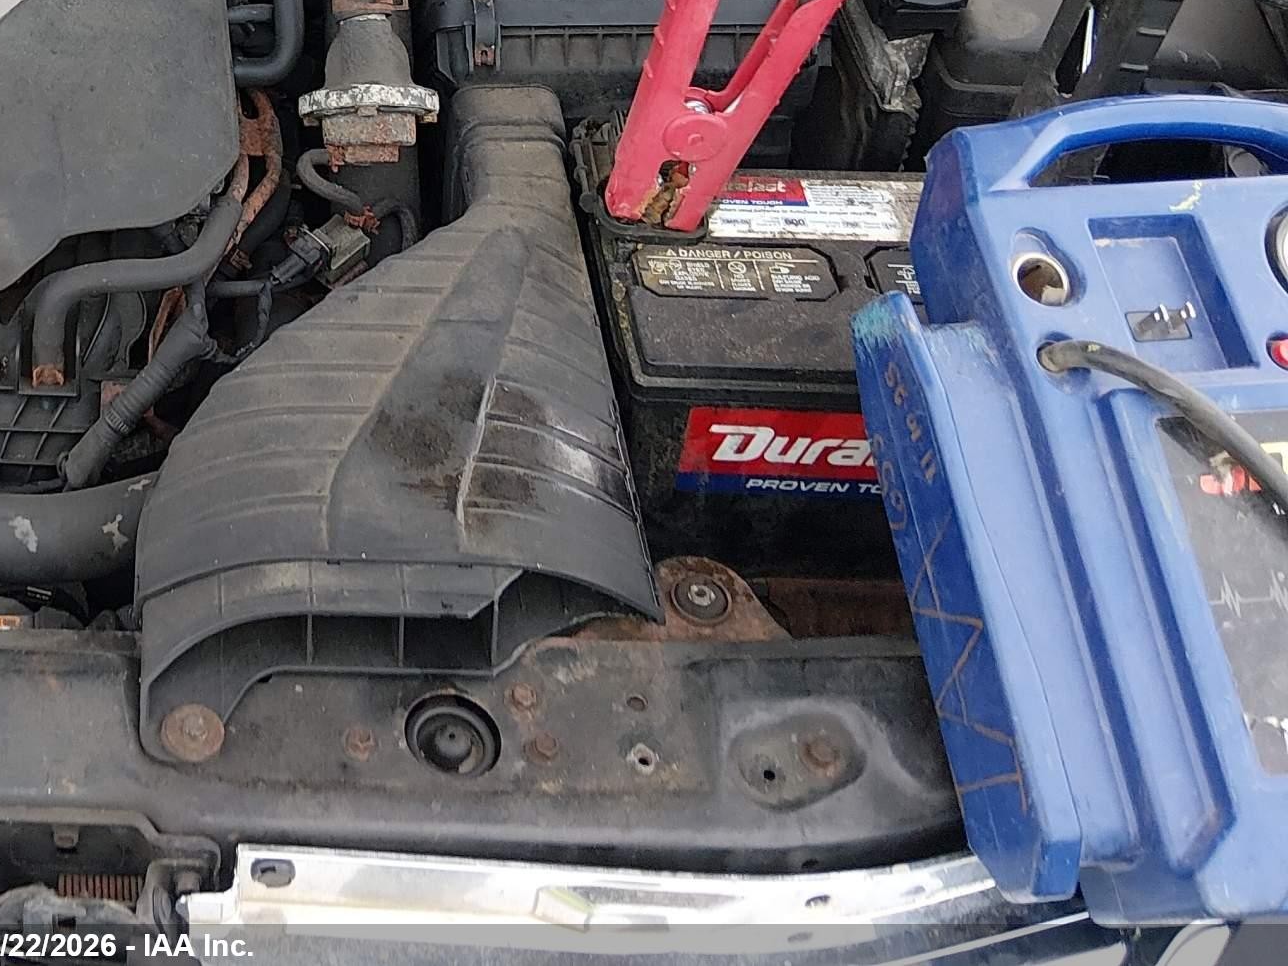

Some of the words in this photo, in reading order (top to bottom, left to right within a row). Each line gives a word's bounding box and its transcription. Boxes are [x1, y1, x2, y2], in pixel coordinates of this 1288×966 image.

[678, 247, 731, 259] DANGER
[743, 250, 793, 260] POISON
[709, 423, 876, 467] Dura
[745, 479, 849, 493] PROVEN
